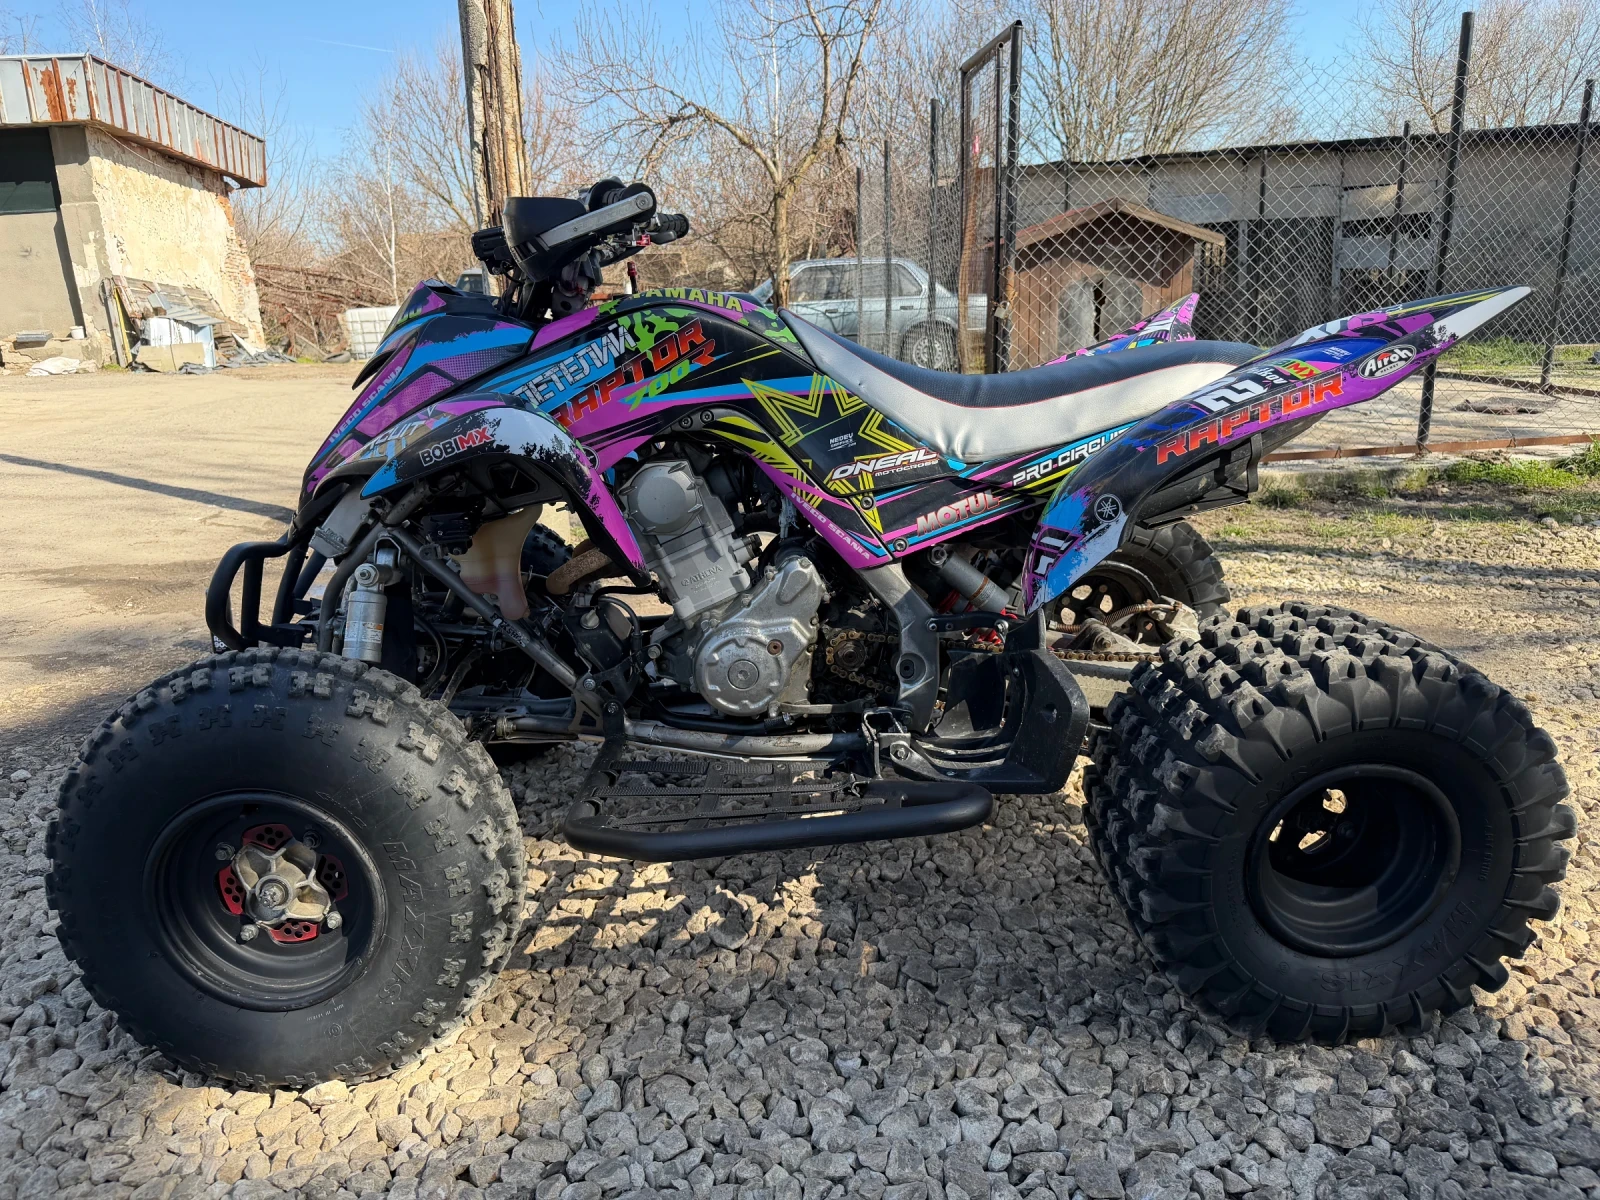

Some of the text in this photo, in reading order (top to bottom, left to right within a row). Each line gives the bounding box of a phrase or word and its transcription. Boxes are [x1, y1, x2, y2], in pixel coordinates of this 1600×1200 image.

[549, 317, 707, 428] RAPTOR
[1364, 346, 1412, 377] Airoh
[362, 366, 404, 410] SCANIA
[1156, 371, 1345, 466] RAPTOR
[419, 426, 495, 467] BOBIMX
[831, 448, 938, 481] ONEAL
[875, 459, 939, 477] MOTOCROSS
[790, 491, 871, 560] IVECO SCANIA
[916, 489, 1001, 537] MOTUL
[379, 841, 425, 1005] MAXXIS
